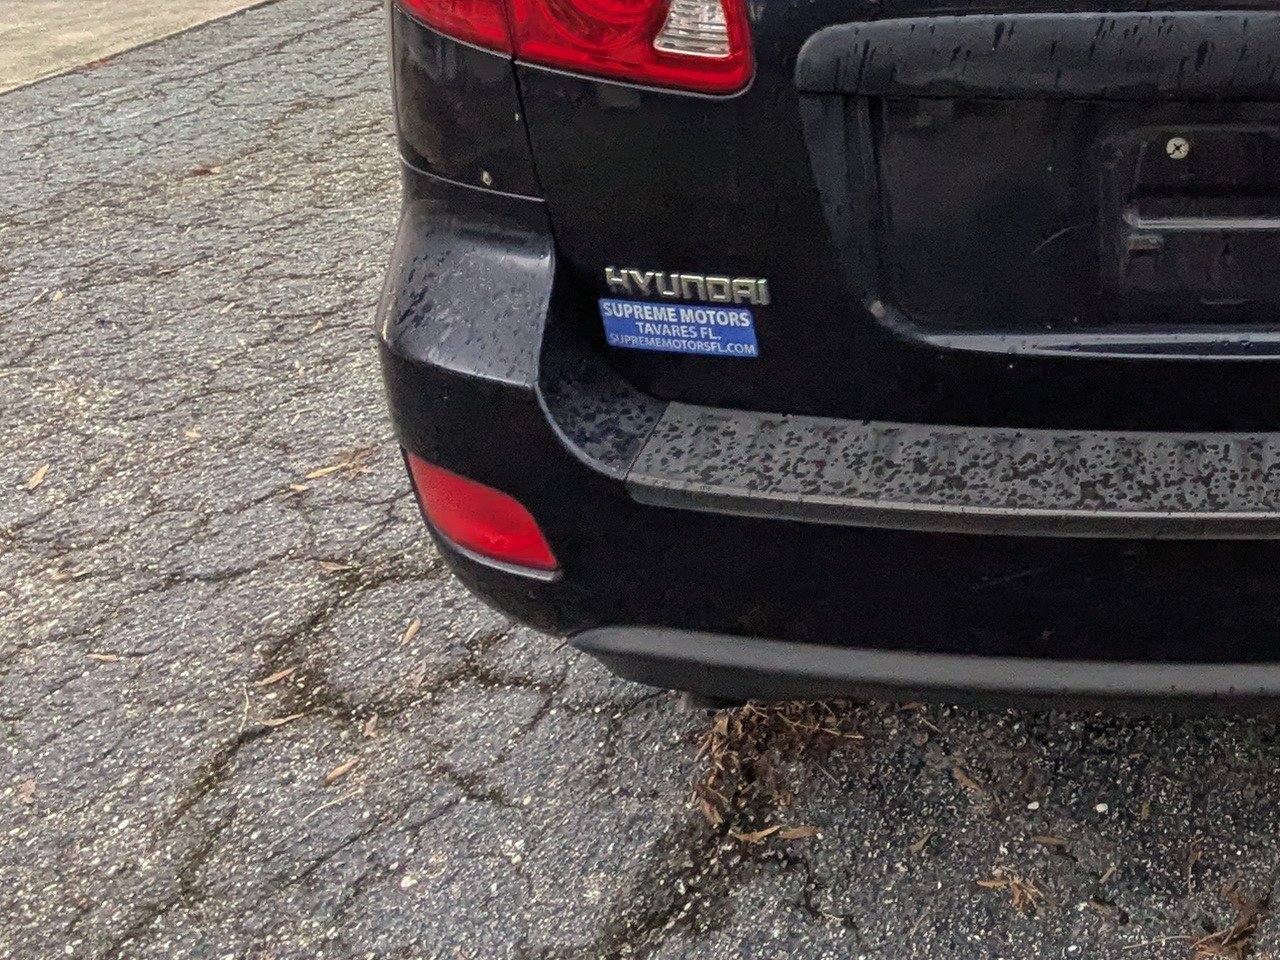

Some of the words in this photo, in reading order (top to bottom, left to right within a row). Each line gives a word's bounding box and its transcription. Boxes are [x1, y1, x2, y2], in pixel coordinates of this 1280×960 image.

[605, 267, 771, 305] HYUNDAI
[603, 302, 677, 322] SUPREME
[680, 309, 750, 327] MOTORS
[635, 322, 697, 338] TAVARES
[609, 333, 757, 355] SUPREMEMOTORSFL.COM
